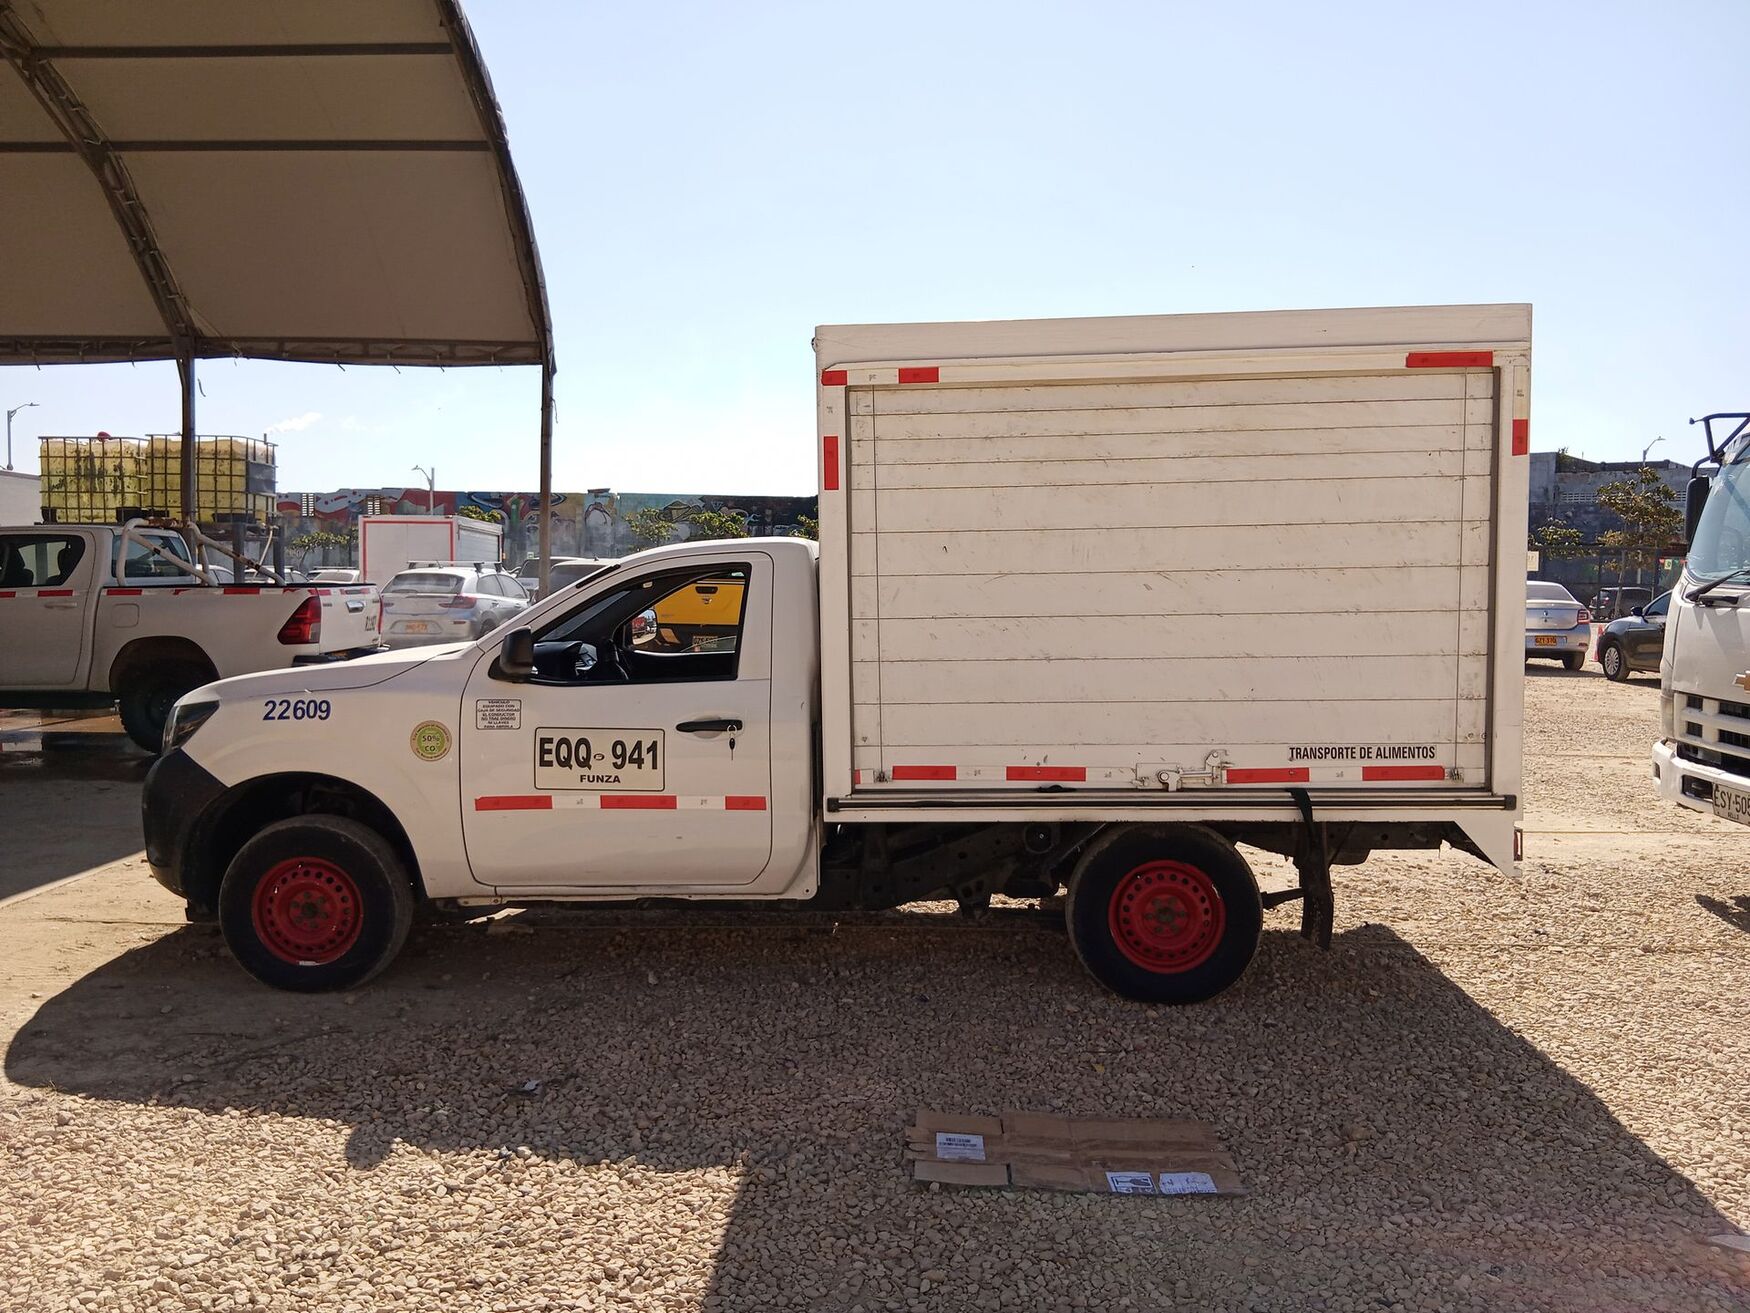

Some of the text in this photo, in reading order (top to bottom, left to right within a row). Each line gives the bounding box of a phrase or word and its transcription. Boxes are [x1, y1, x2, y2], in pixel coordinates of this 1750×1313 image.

[263, 699, 332, 721] 22609
[539, 737, 658, 771] EQQ 941
[1289, 746, 1435, 760] TRANSPORTE DE ALIMENTOS
[580, 774, 621, 784] FUNZA
